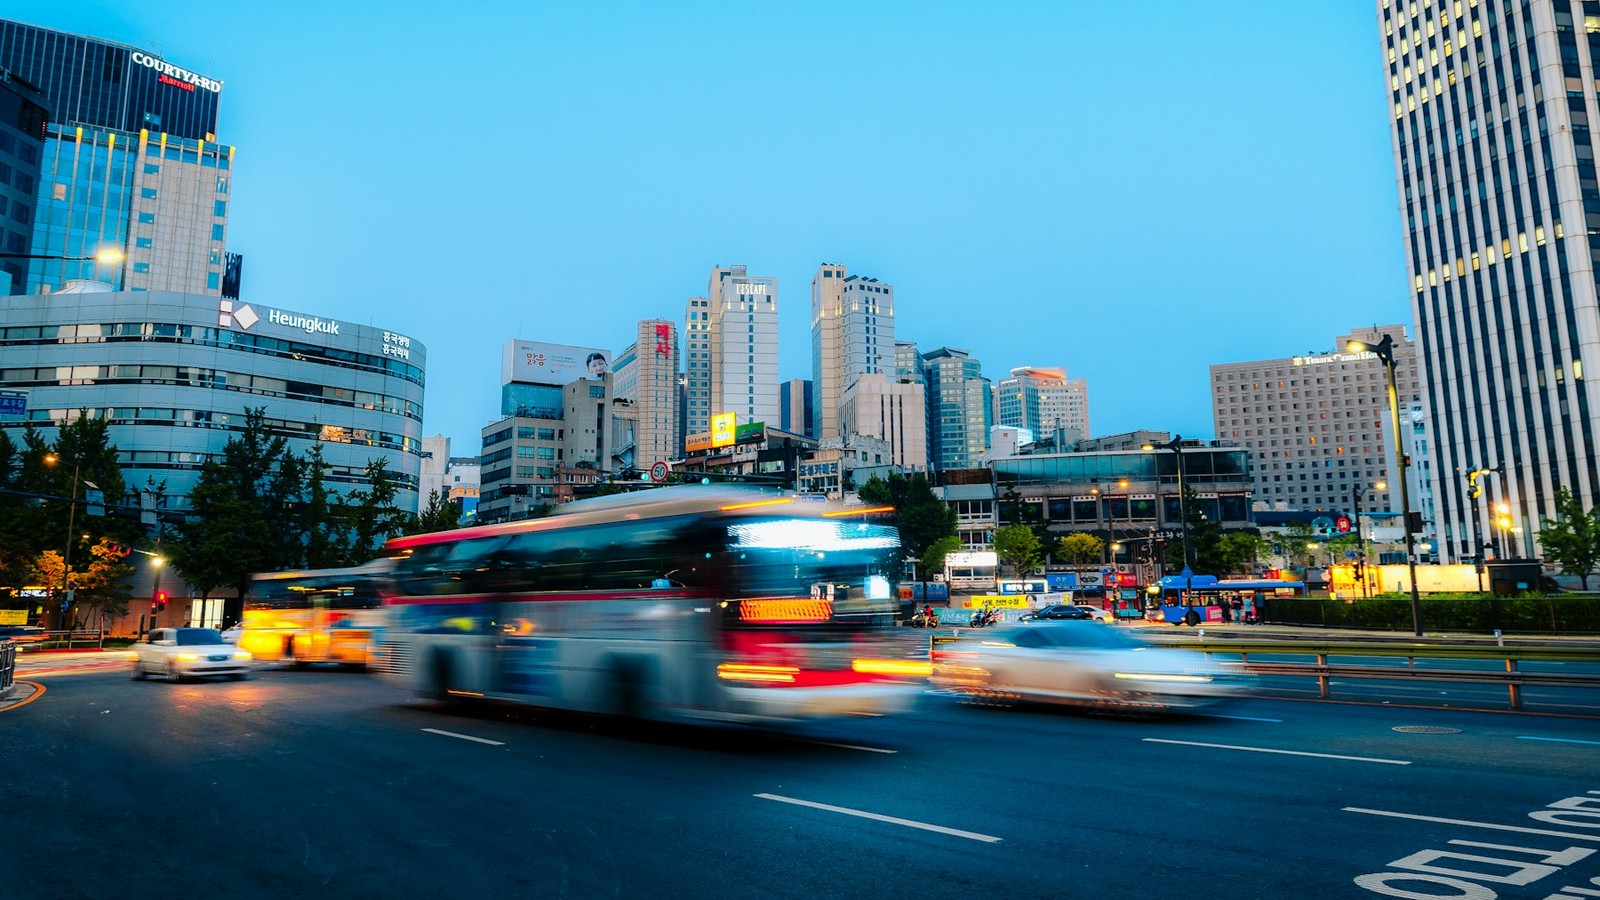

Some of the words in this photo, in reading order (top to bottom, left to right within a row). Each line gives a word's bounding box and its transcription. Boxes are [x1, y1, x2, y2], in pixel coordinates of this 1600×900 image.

[132, 51, 221, 93] COURTYARD
[736, 283, 767, 295] L'ESCAPE
[269, 309, 339, 335] Heungkuk
[382, 331, 410, 347] 흥국생명
[382, 343, 409, 360] 흥국화재
[1304, 356, 1333, 365] Tmark
[1361, 350, 1386, 360] Hot
[526, 352, 547, 367] 맑음
[654, 466, 665, 478] 50
[1062, 593, 1070, 605] 3
